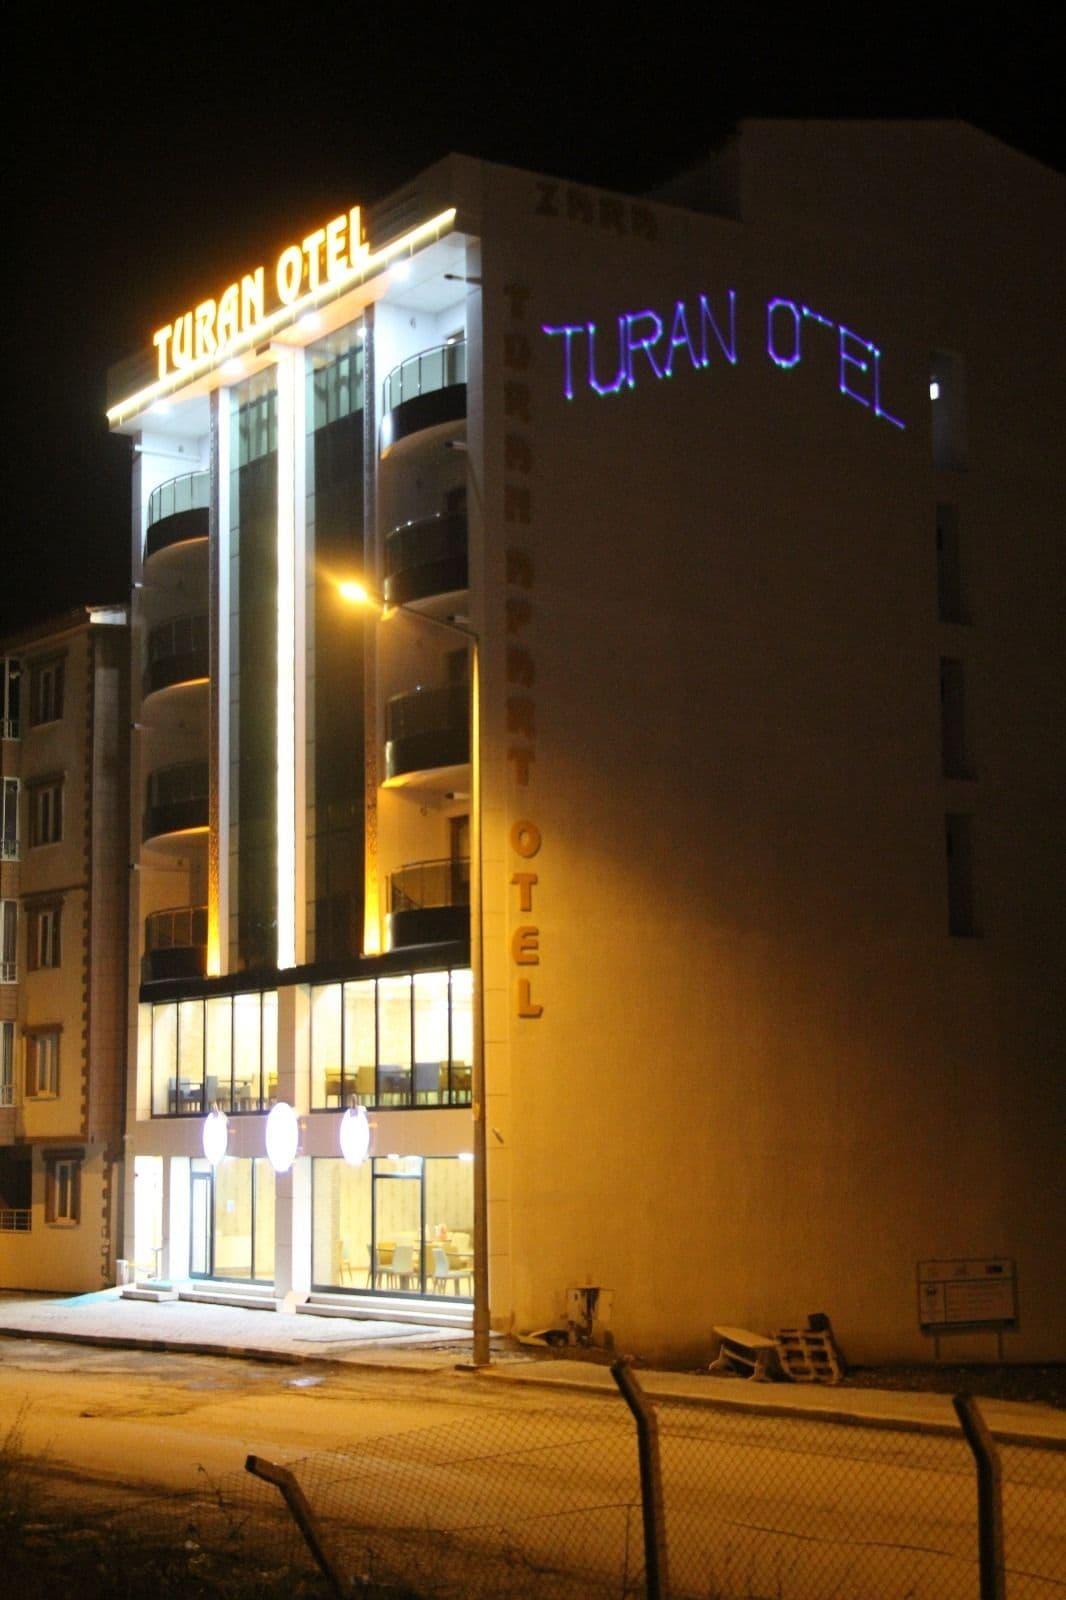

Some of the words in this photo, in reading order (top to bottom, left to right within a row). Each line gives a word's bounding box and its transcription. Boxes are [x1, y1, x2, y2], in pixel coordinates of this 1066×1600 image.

[153, 266, 264, 382] TURAN
[275, 205, 370, 305] OTEL
[542, 289, 737, 400] TURAN
[510, 819, 543, 1019] OTEL
